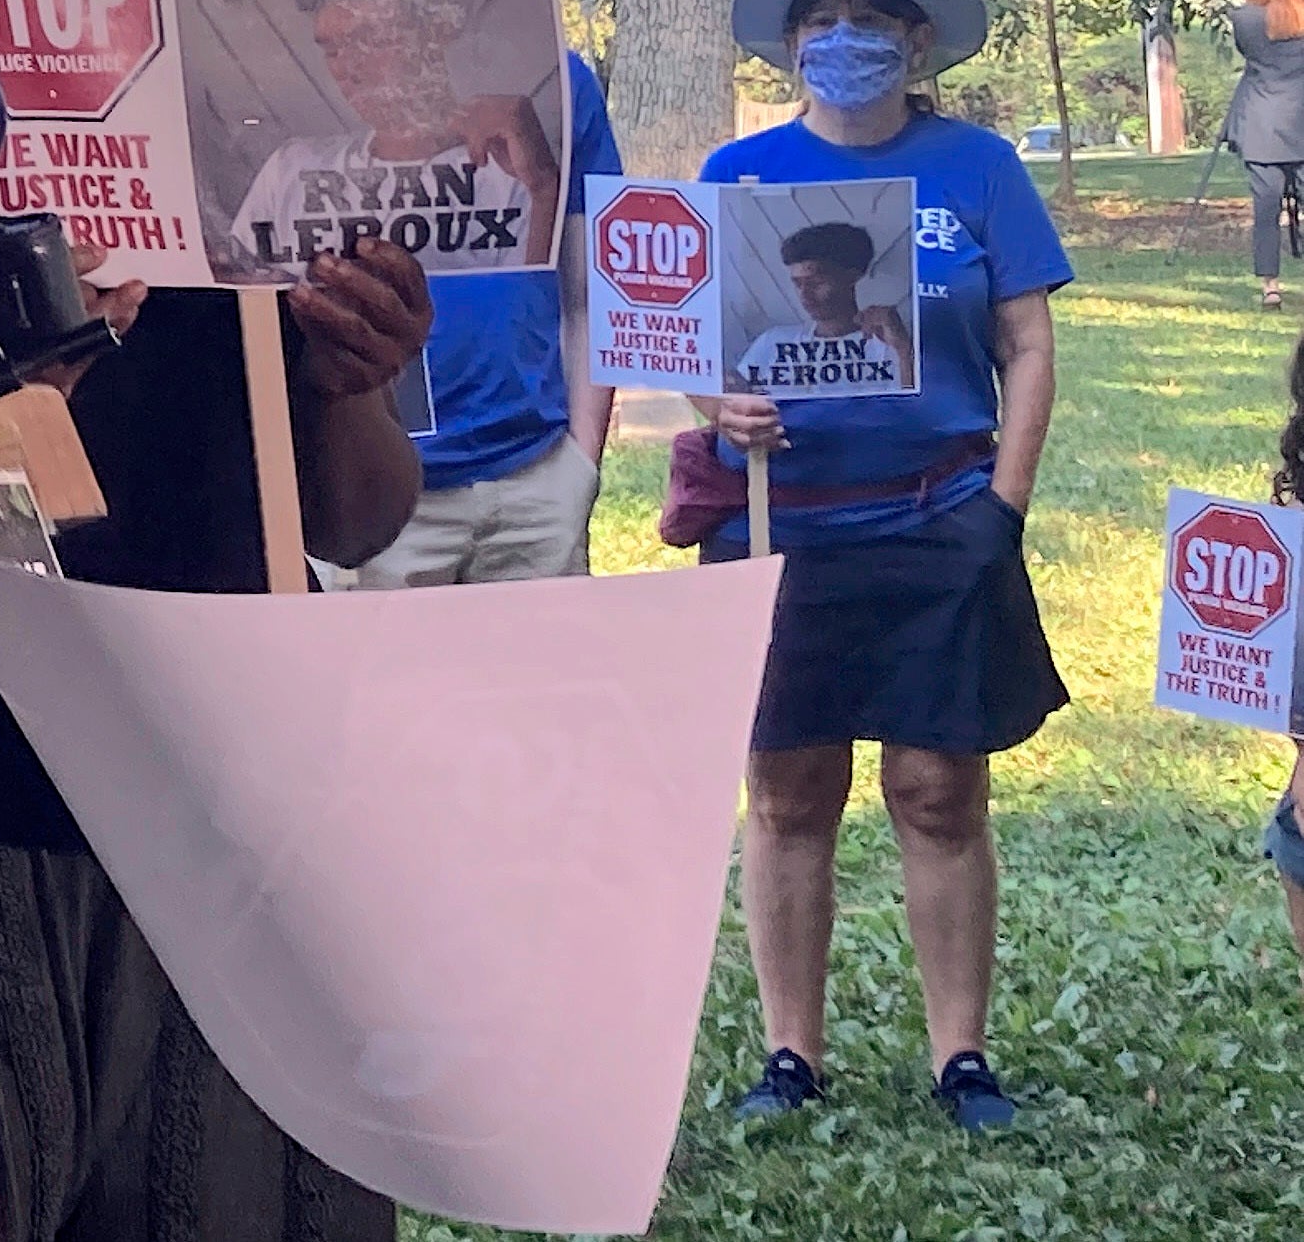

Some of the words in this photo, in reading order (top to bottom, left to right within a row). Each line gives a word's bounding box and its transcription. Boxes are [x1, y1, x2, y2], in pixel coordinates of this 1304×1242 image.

[41, 134, 150, 169] WANT
[129, 178, 153, 210] &
[299, 163, 477, 212] RYAN
[61, 215, 167, 250] RUTH
[172, 217, 187, 250] !
[251, 209, 522, 263] LEROUX
[607, 219, 701, 276] STOP
[608, 311, 639, 330] WE
[643, 313, 702, 336] WANT
[613, 331, 679, 353] JUSTICE
[686, 338, 697, 354] &
[775, 338, 868, 363] RYAN
[598, 350, 634, 369] THE
[639, 353, 701, 376] TRUTH
[748, 360, 894, 386] LEROUX
[1183, 536, 1280, 603] STOP
[1178, 631, 1209, 656] WE
[1215, 639, 1273, 668] WANT
[1180, 654, 1248, 685] JUSTICE
[1254, 670, 1265, 689] &
[1165, 670, 1202, 698] THE
[1206, 680, 1269, 711] TRUTH
